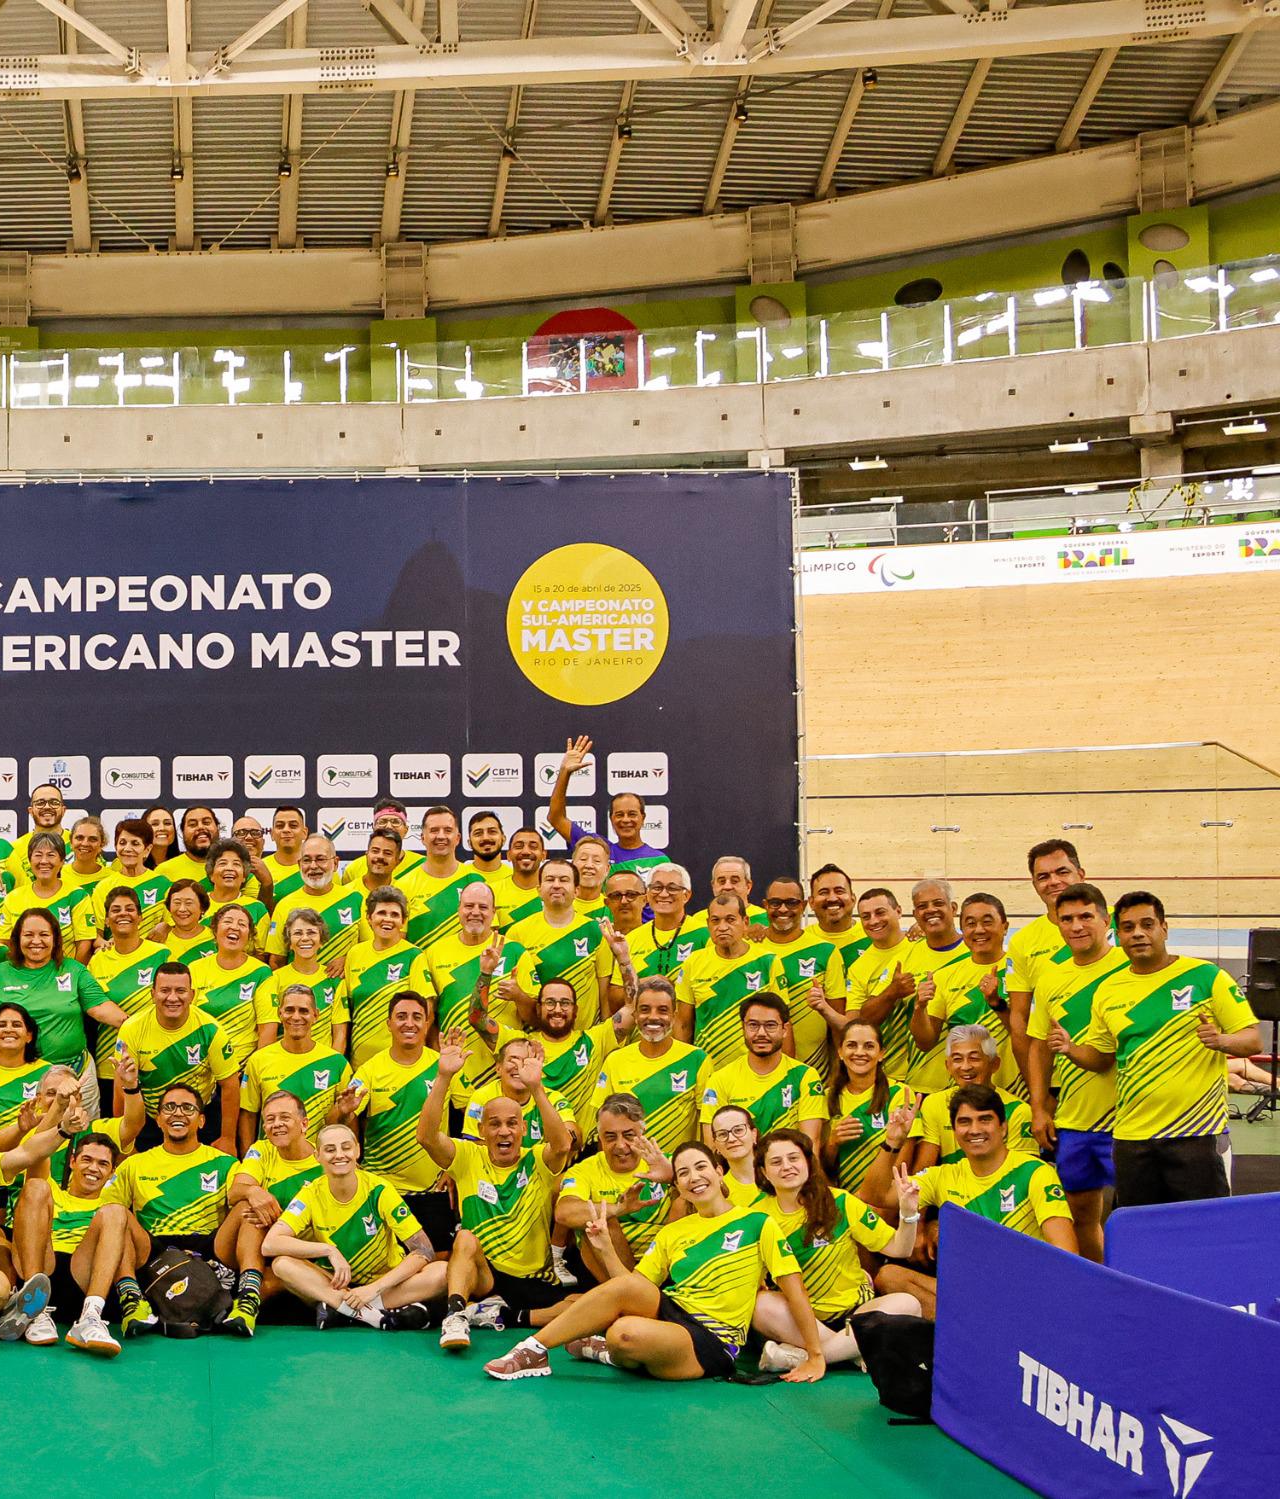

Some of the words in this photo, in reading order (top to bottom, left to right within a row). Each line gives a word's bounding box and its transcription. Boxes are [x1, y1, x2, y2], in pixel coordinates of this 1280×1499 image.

[533, 585, 541, 593] 15
[553, 585, 565, 593] 20
[567, 584, 579, 593] de
[581, 584, 602, 593] abril
[604, 584, 616, 592] de
[618, 584, 642, 592] 2025
[521, 600, 534, 613] V
[537, 598, 655, 612] CAMPEONATO
[521, 613, 655, 626] SUL-AMERICANO
[520, 627, 655, 652] MASTER
[250, 629, 462, 669] MASTER
[534, 658, 557, 666] RIO
[563, 657, 579, 666] DE
[586, 657, 643, 666] JANEIRO
[274, 769, 301, 777] CBTM
[393, 772, 431, 780] TIBHAR
[492, 768, 519, 776] CBTM
[611, 770, 649, 779] TIBHAR
[176, 773, 214, 782] TIBHAR
[48, 778, 72, 789] RIO
[347, 822, 374, 830] CBTM
[1018, 1350, 1145, 1476] TIBHAR
